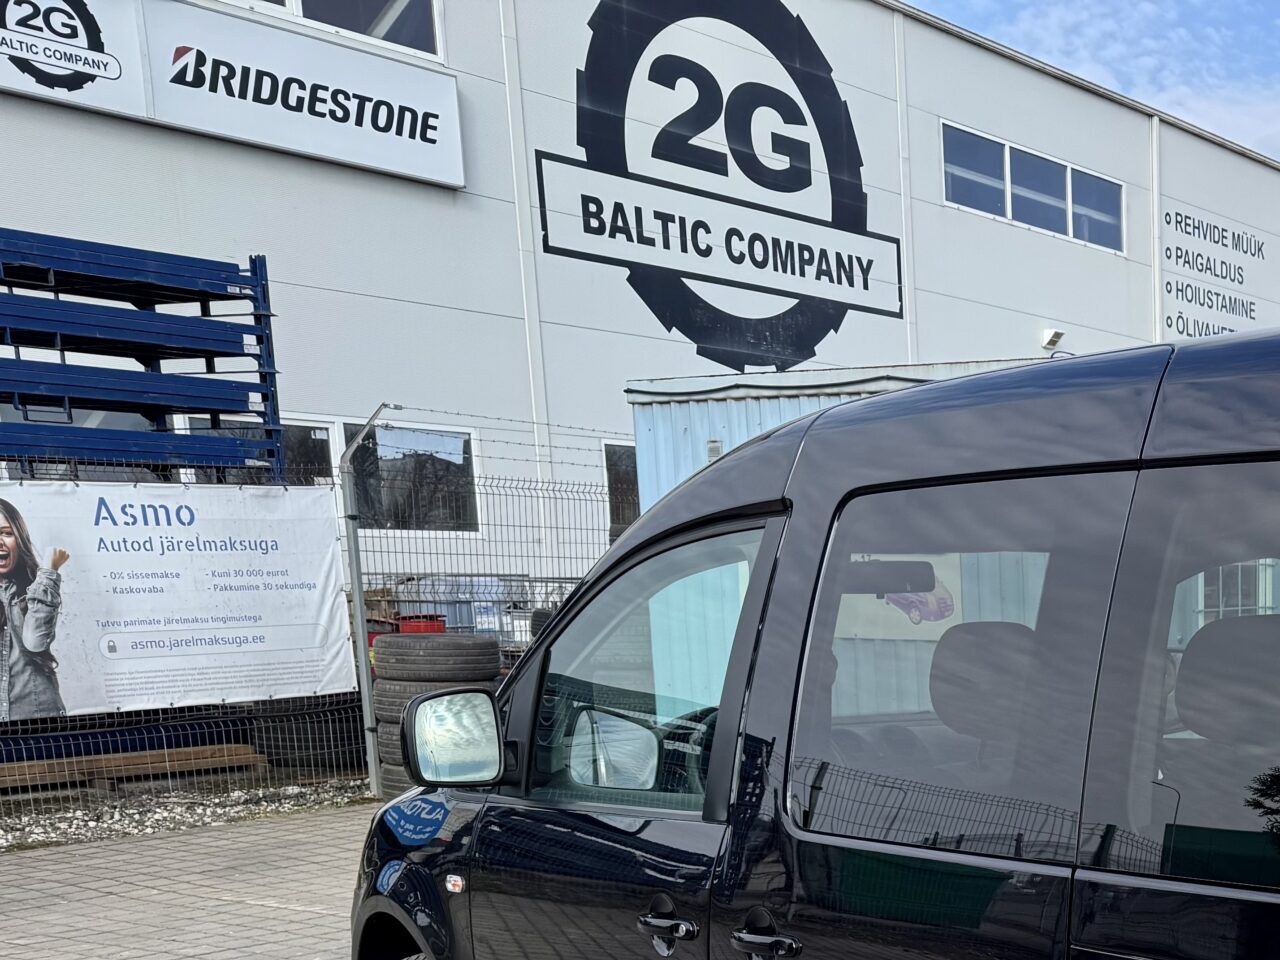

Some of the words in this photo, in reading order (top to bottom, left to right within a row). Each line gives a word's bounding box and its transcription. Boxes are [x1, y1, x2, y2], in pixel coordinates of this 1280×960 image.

[13, 0, 79, 39] 2G
[0, 36, 39, 55] ALTIC
[43, 47, 109, 72] COMPANY
[169, 46, 440, 145] BRIDGESTONE
[647, 54, 812, 193] 2G
[581, 194, 713, 258] BALTIC
[725, 227, 874, 290] COMPANY
[1175, 211, 1228, 248] REHVIDE
[1231, 231, 1265, 260] MÜÜK
[1175, 246, 1244, 285] PAIGALDUS
[1175, 280, 1256, 320] HOIUSTAMINE
[94, 497, 195, 527] Asmo
[97, 536, 153, 553] Autod
[159, 536, 279, 556] järelmaksuga
[127, 570, 180, 580] sissemakse
[211, 569, 231, 578] Kuni
[233, 569, 244, 578] 30
[246, 568, 264, 577] 000
[266, 568, 289, 577] eurot
[213, 582, 260, 592] Pakkumine
[263, 582, 273, 590] 30
[275, 581, 317, 591] sekundiga
[112, 585, 164, 595] Kaskovaba
[96, 619, 121, 628] Tutvu
[124, 617, 161, 628] parimate
[163, 615, 209, 627] järelmaksu
[211, 614, 262, 625] tingimustega
[131, 634, 265, 651] asmo.jarelmaksuga.ee
